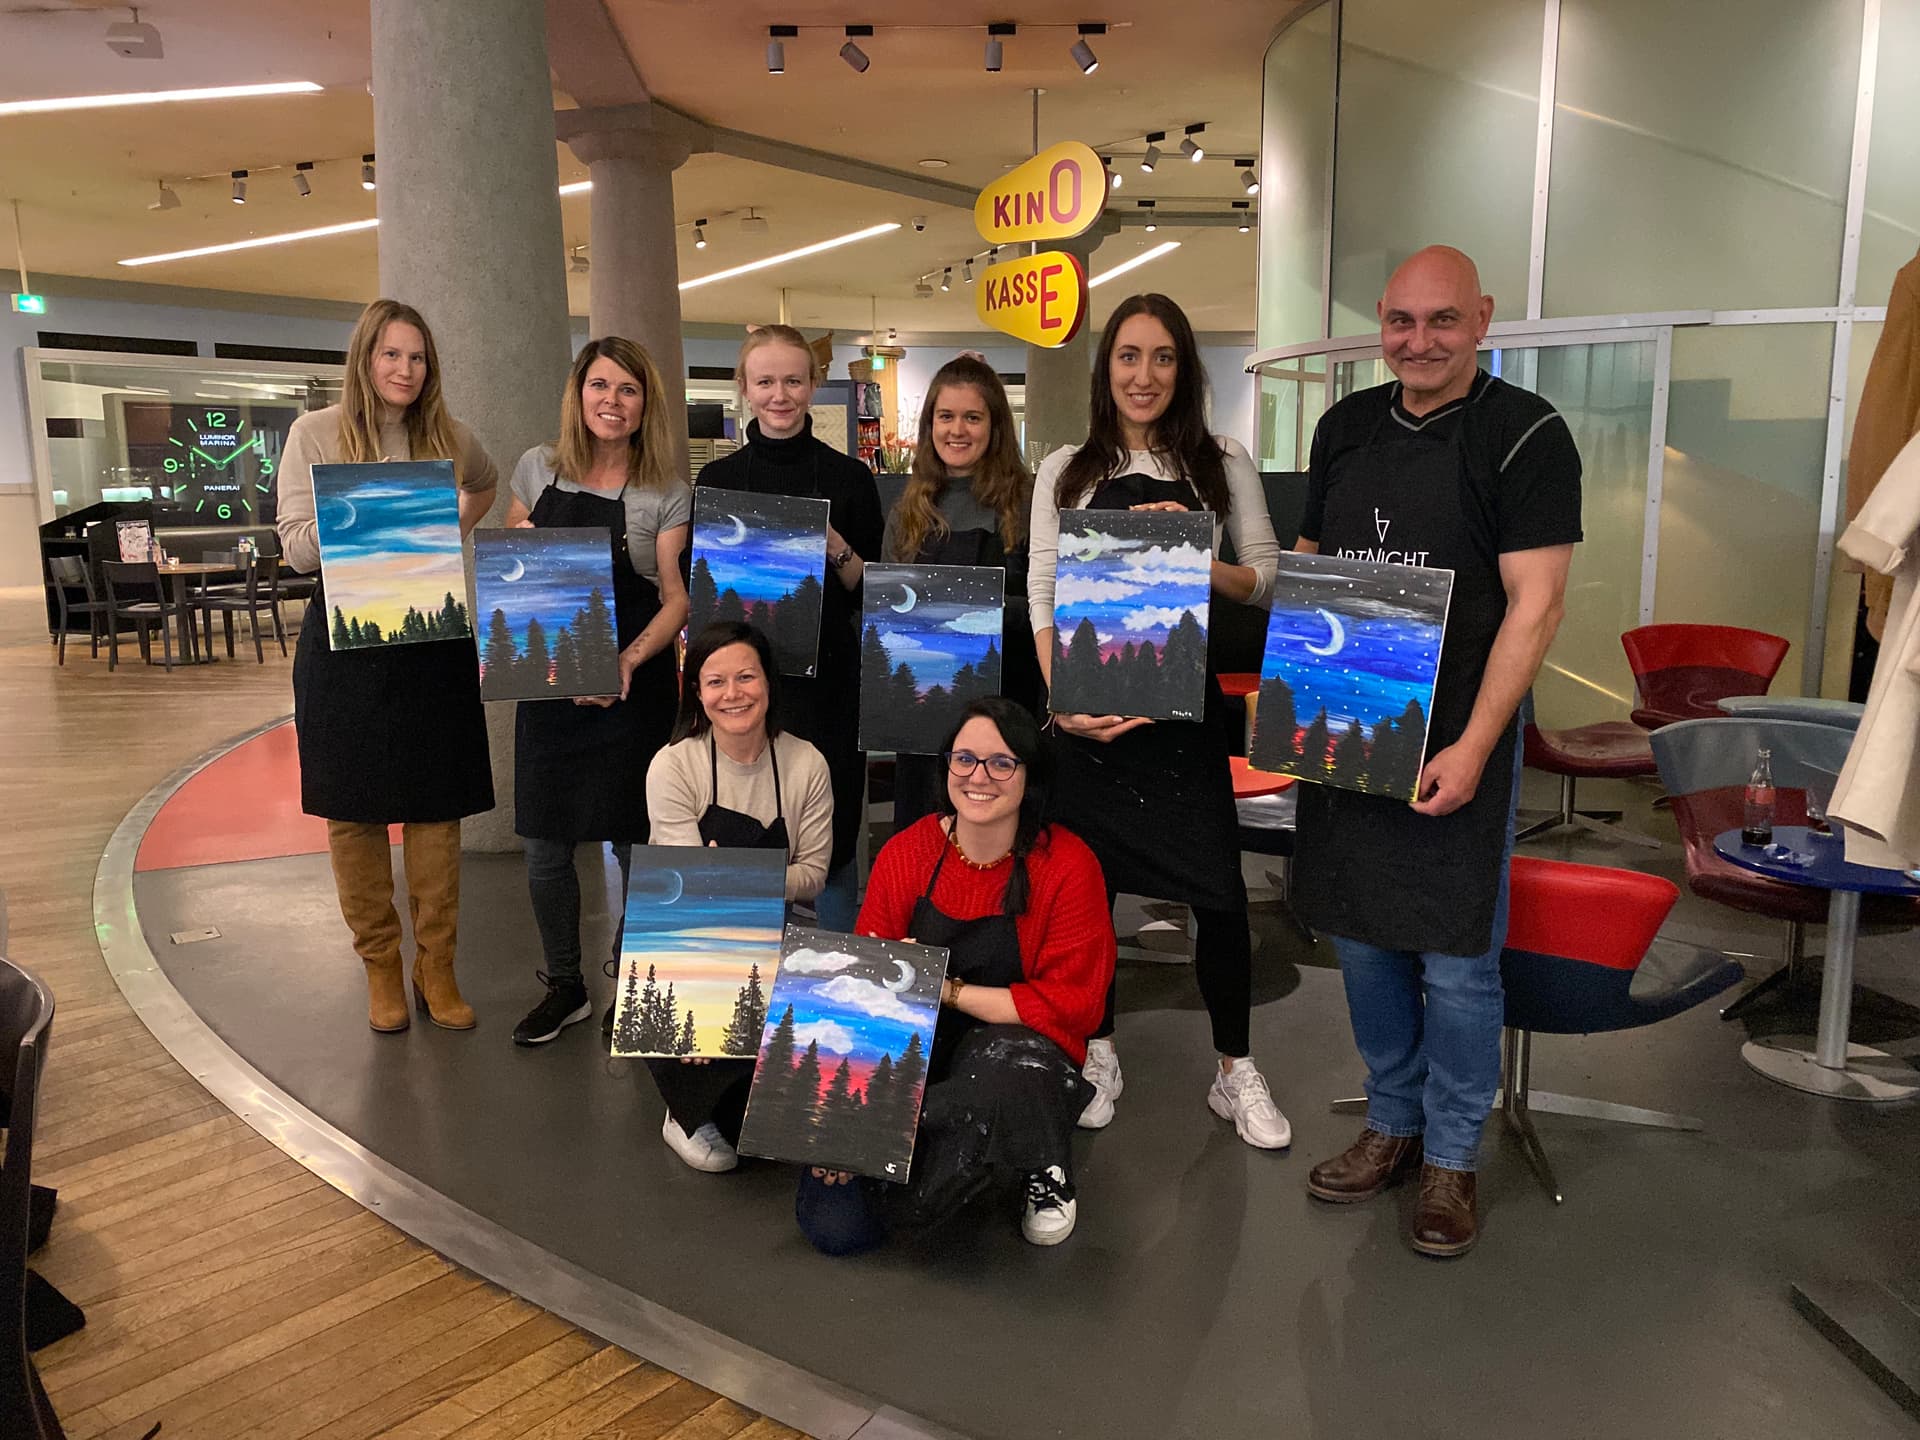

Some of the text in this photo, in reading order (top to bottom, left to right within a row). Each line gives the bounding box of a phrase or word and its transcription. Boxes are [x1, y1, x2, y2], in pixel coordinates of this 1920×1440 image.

[993, 158, 1082, 229] KINO
[985, 264, 1063, 330] KASSE
[206, 412, 227, 428] 12
[163, 458, 178, 473] 9
[260, 458, 274, 474] 3
[203, 484, 240, 492] PANERAI
[217, 504, 232, 519] 6
